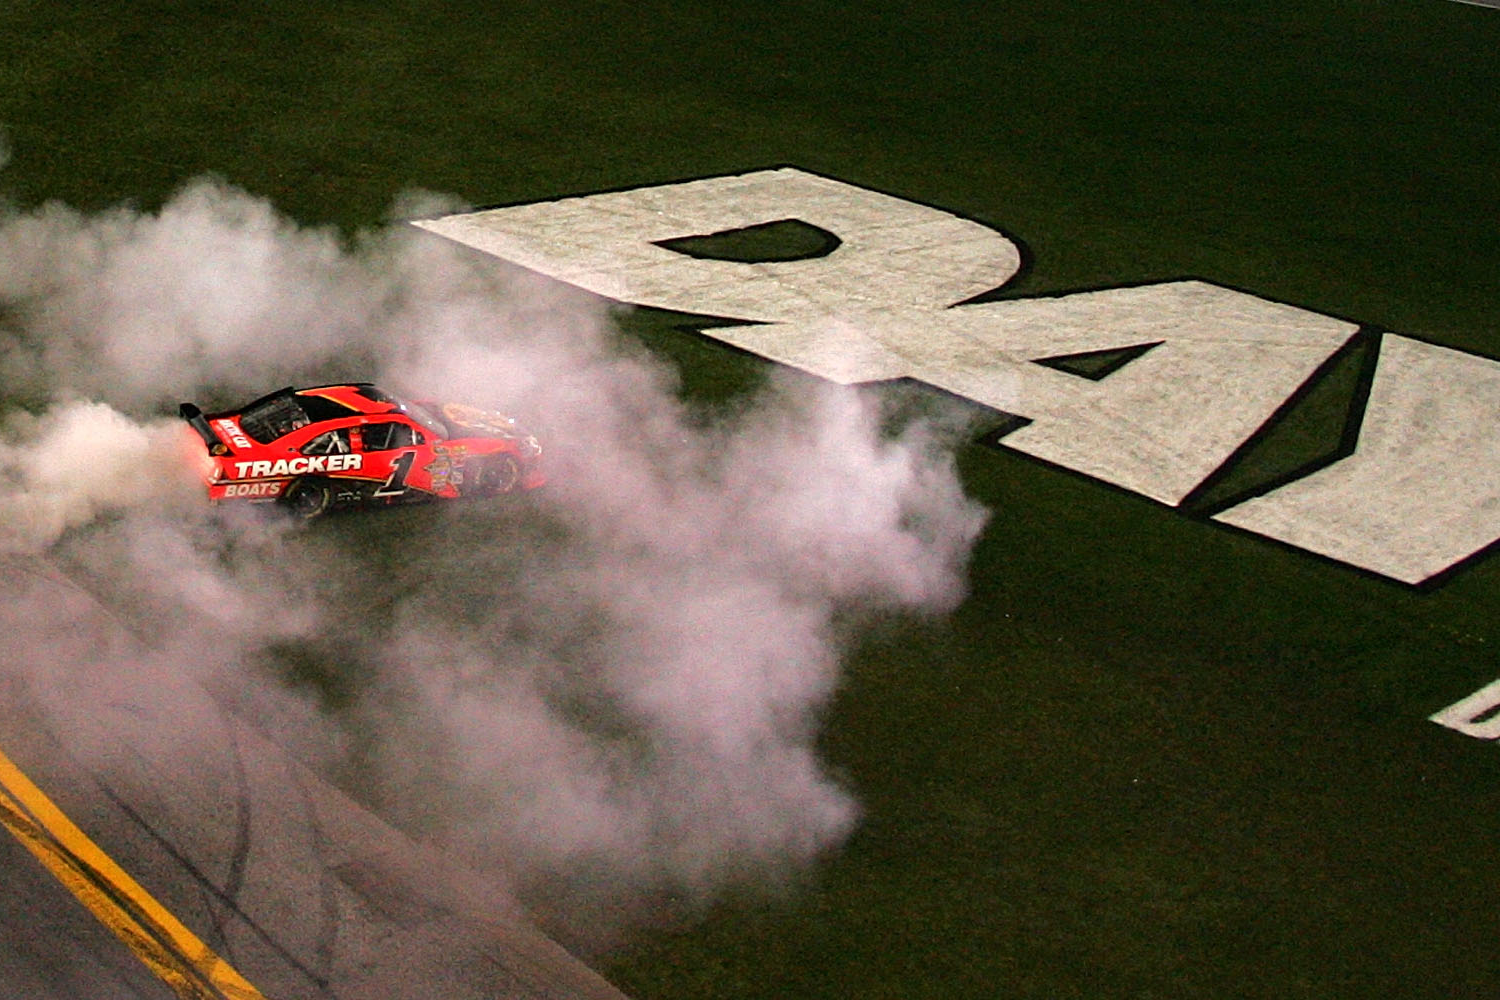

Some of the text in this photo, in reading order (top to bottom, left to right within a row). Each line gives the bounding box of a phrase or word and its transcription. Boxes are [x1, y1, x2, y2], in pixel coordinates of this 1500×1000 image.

[234, 454, 362, 478] TRACKER
[373, 450, 417, 497] 1
[224, 482, 282, 497] BOATS
